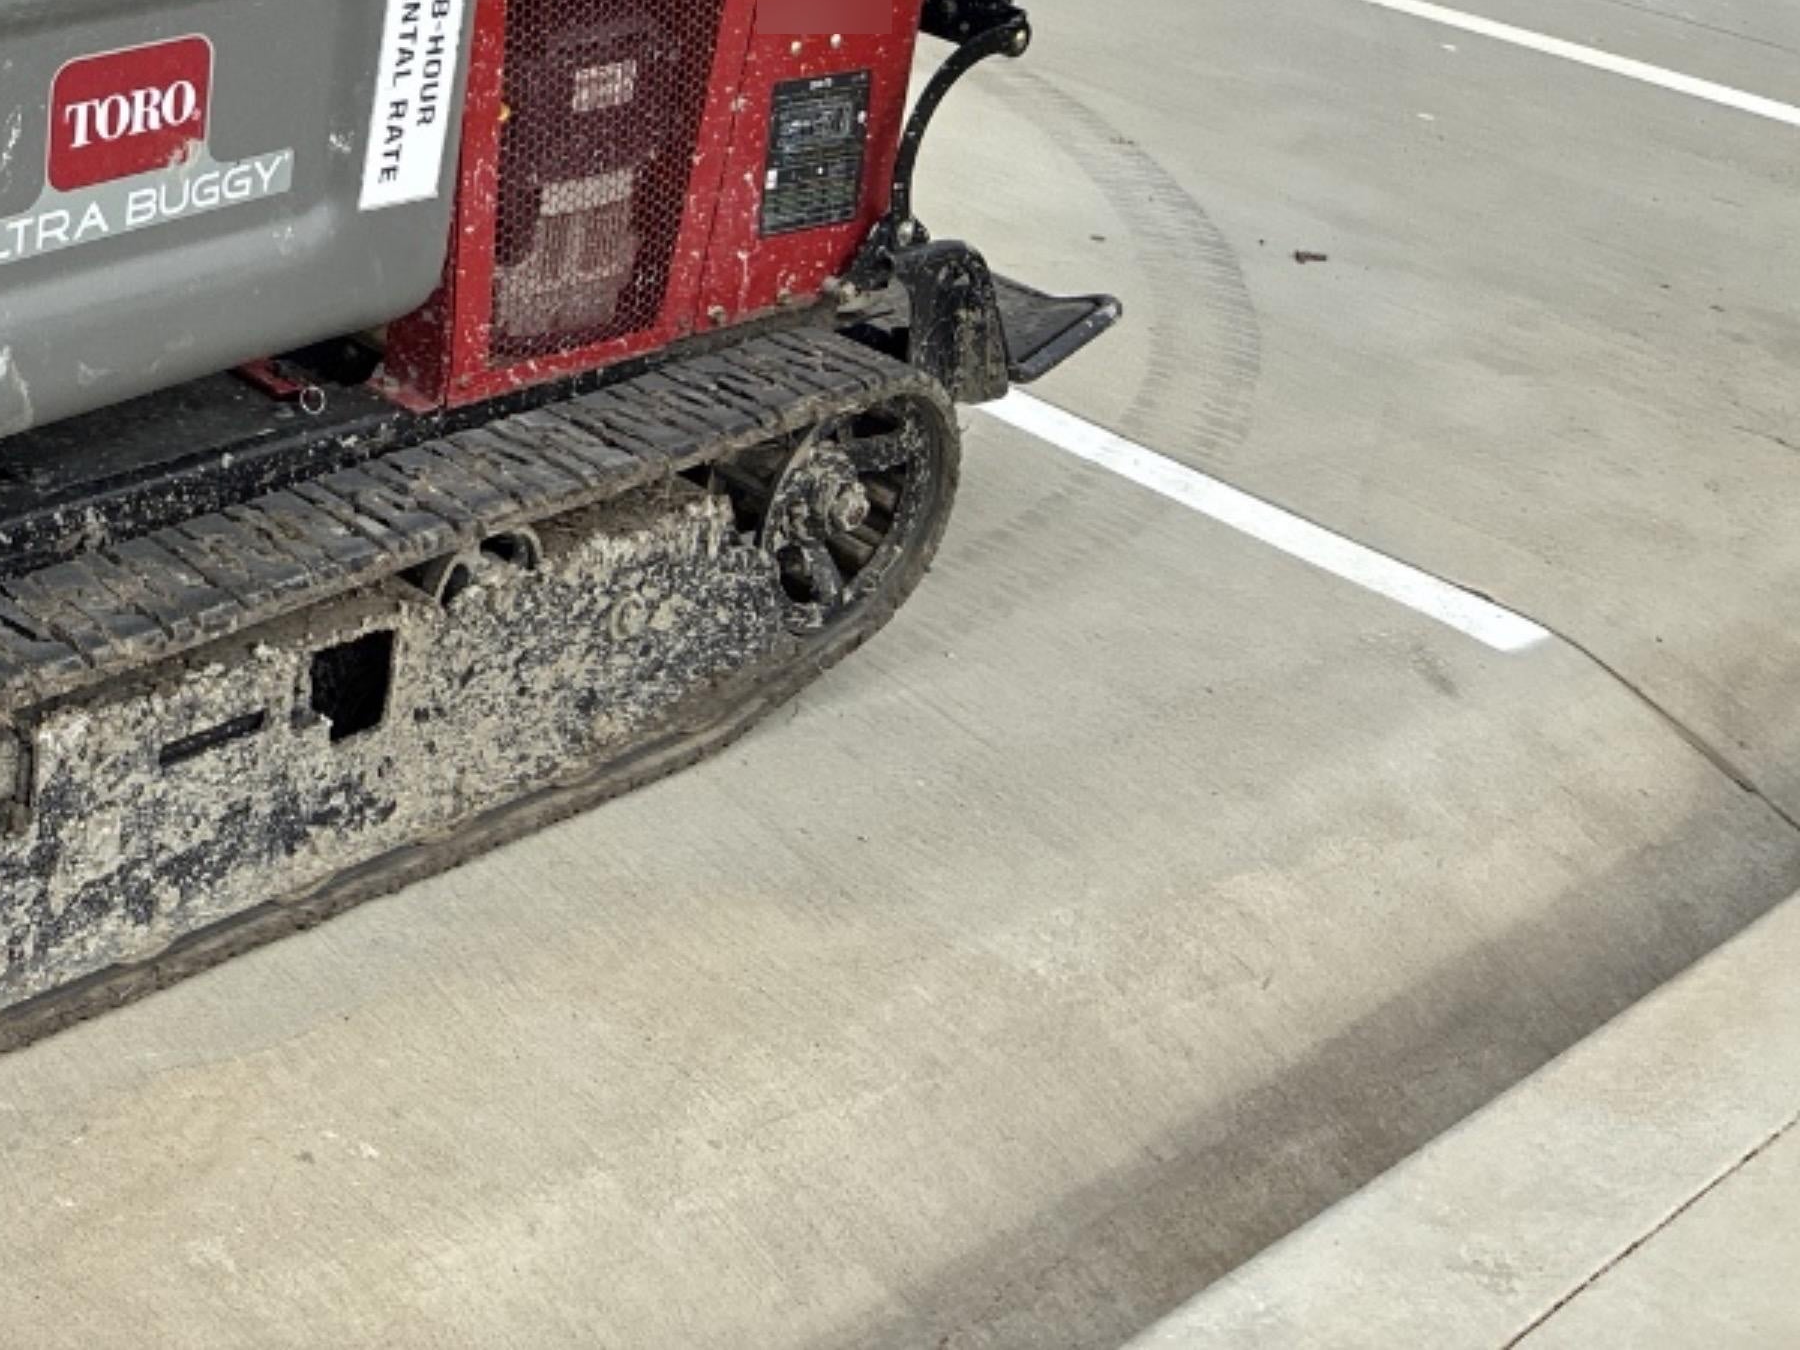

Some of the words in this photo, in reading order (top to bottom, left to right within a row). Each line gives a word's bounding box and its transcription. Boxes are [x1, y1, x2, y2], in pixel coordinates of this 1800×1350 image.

[64, 79, 196, 149] TORO
[377, 98, 409, 183] RATE
[125, 153, 283, 228] BUGGY
